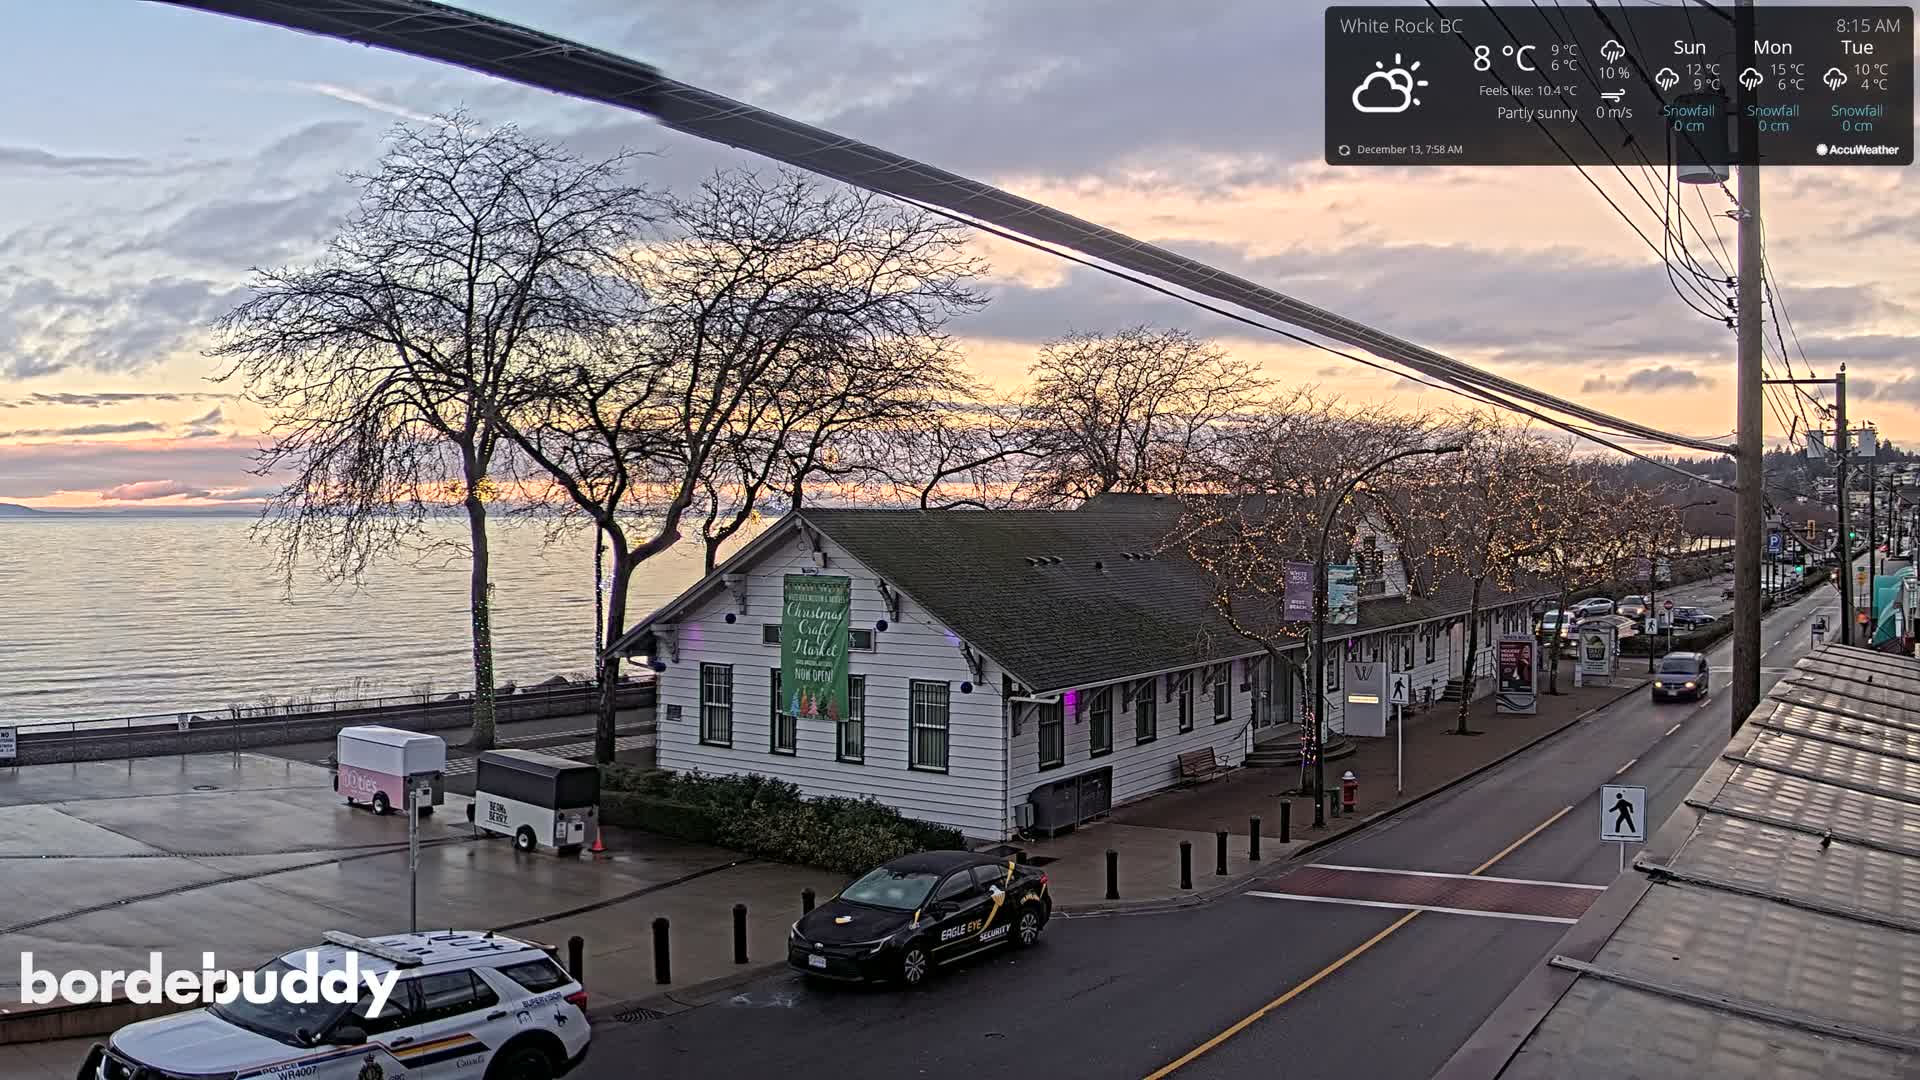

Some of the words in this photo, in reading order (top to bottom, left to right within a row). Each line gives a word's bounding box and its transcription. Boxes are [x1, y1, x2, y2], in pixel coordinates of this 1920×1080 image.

[787, 601, 842, 620] Christmas
[798, 618, 830, 645] Craft
[792, 638, 838, 657] Market
[794, 667, 811, 681] NOW
[812, 669, 833, 683] OPEN!
[488, 811, 508, 824] BERRY
[941, 924, 967, 941] EAGLE
[967, 918, 982, 933] EYE
[979, 923, 1012, 942] SECURITY
[262, 1062, 298, 1075] POLICE
[277, 1065, 318, 1080] WR4007
